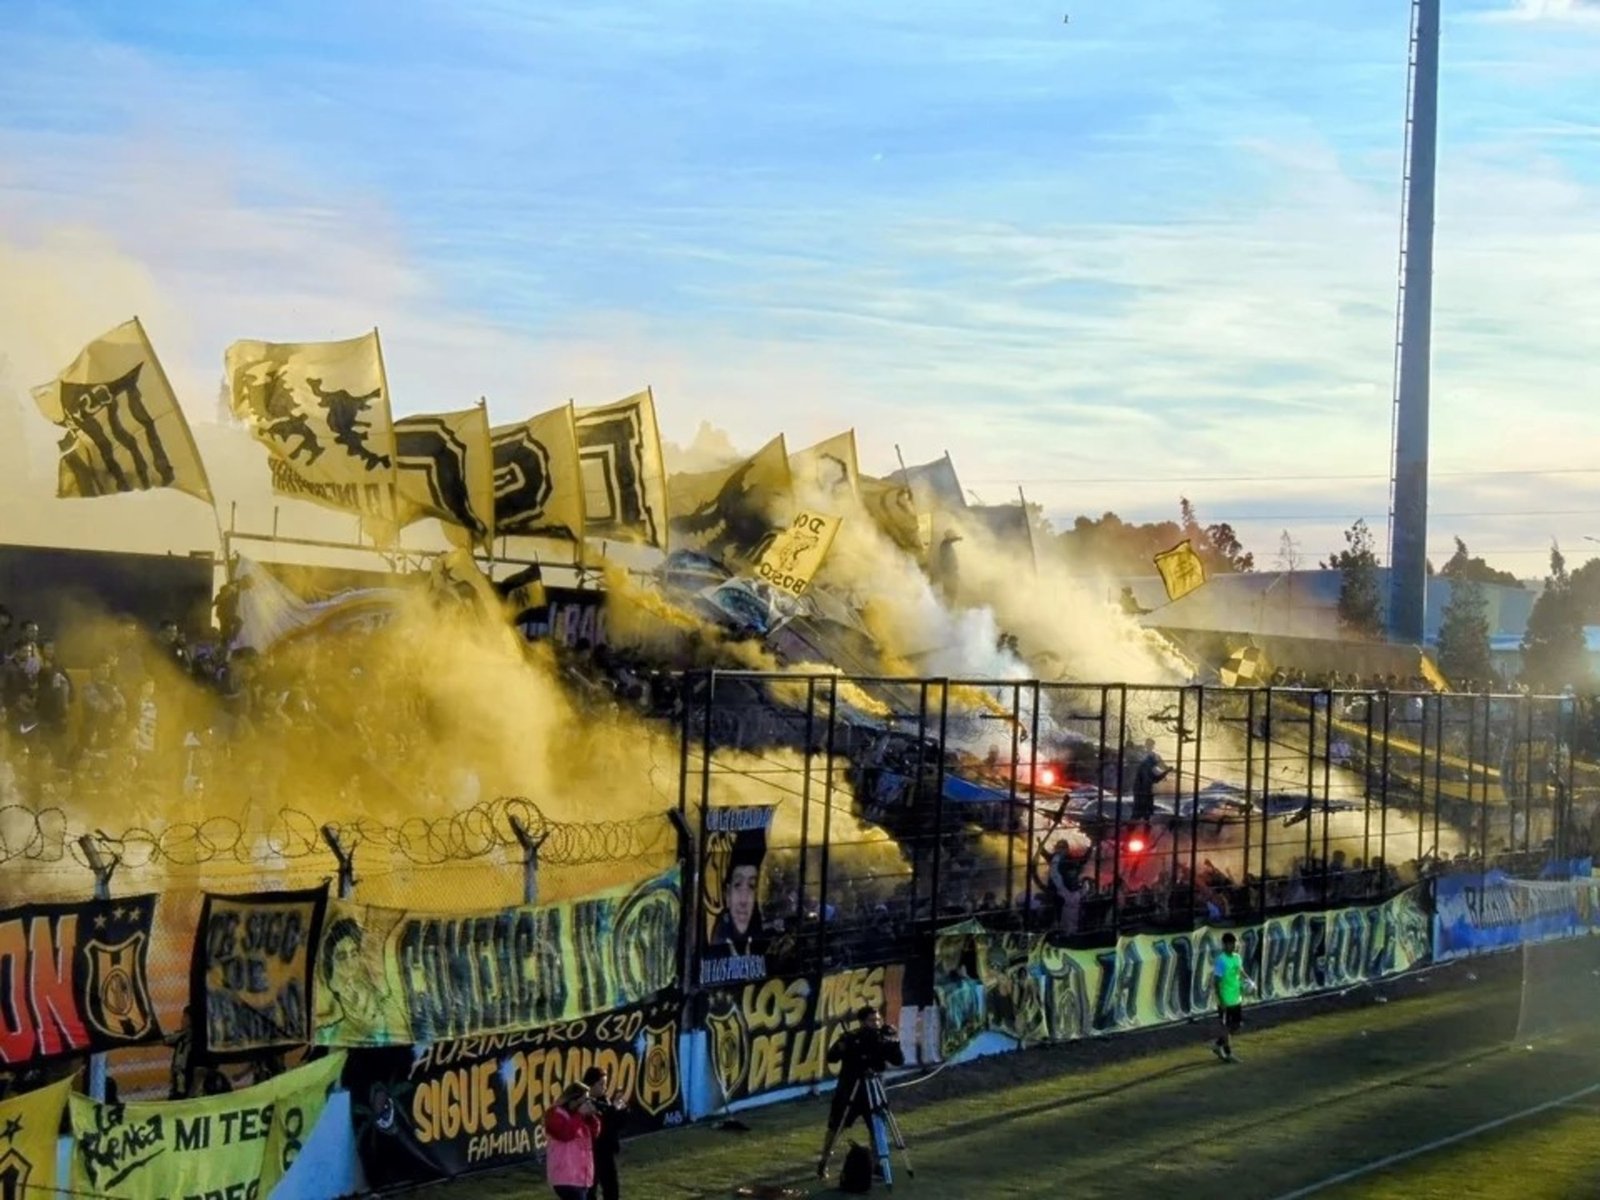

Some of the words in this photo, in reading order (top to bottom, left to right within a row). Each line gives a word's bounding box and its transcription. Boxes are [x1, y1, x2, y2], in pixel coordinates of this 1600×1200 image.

[743, 978, 811, 1030] LOS
[596, 1011, 643, 1042] 630
[748, 1032, 788, 1092] DE
[412, 1058, 498, 1143] SIGUE
[174, 1115, 211, 1152] MI
[467, 1126, 531, 1163] FAMILIA
